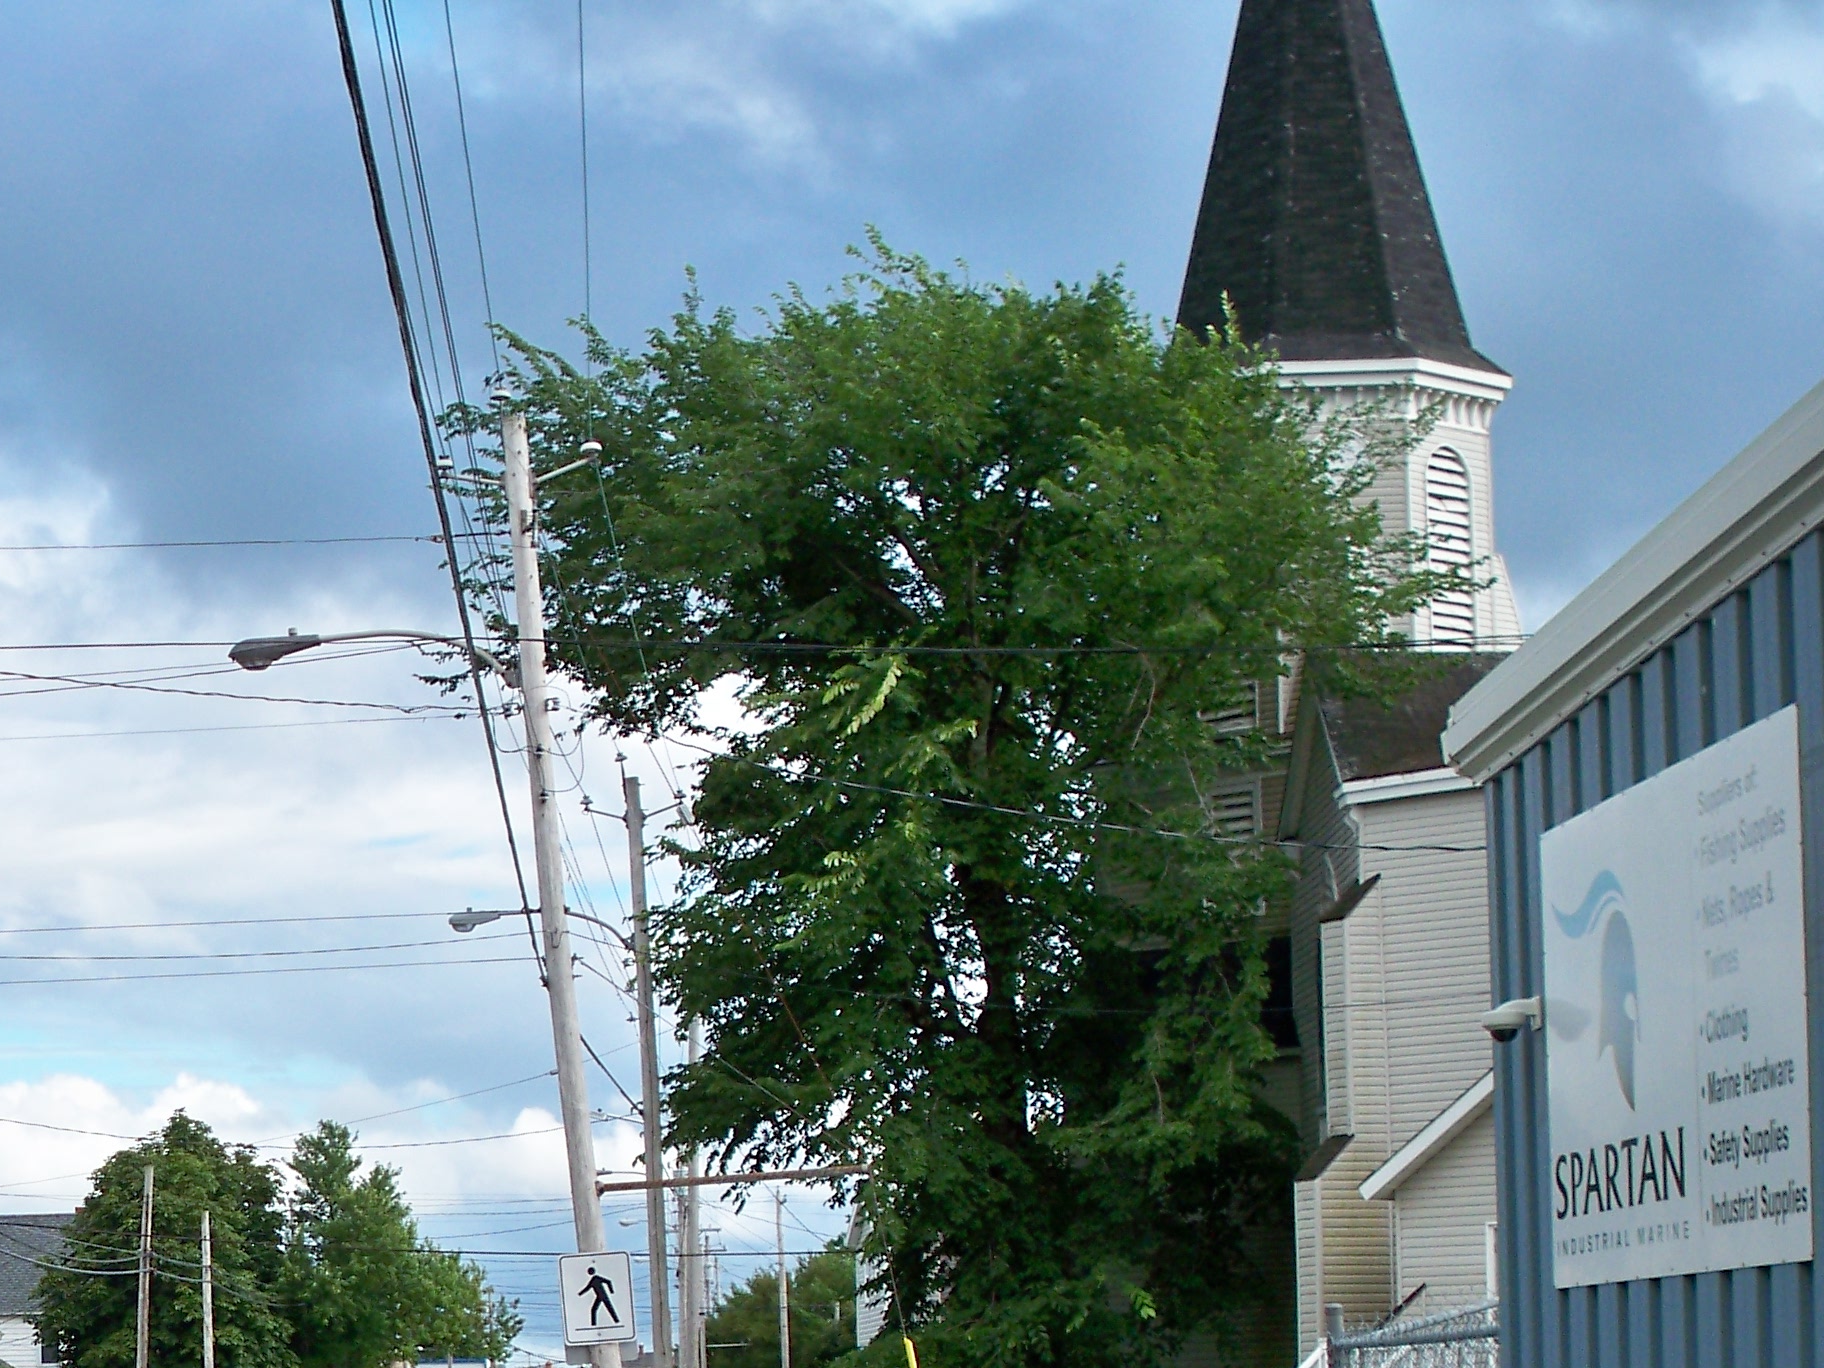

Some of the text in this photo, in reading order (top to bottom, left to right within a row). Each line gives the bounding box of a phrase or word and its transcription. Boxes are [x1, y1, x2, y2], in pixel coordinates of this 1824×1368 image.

[1745, 764, 1757, 793] of
[1700, 806, 1787, 869] Fishing Supplies
[1729, 884, 1763, 921] Ropes
[1706, 1004, 1748, 1043] Clothing
[1707, 1056, 1795, 1105] Marine Hardware
[1709, 1119, 1790, 1169] Safety Supplies
[1556, 1126, 1687, 1220] SPARTAN
[1711, 1180, 1808, 1227] Industrial Supplies
[1556, 1220, 1690, 1257] INDUSTRIAL MARINE
